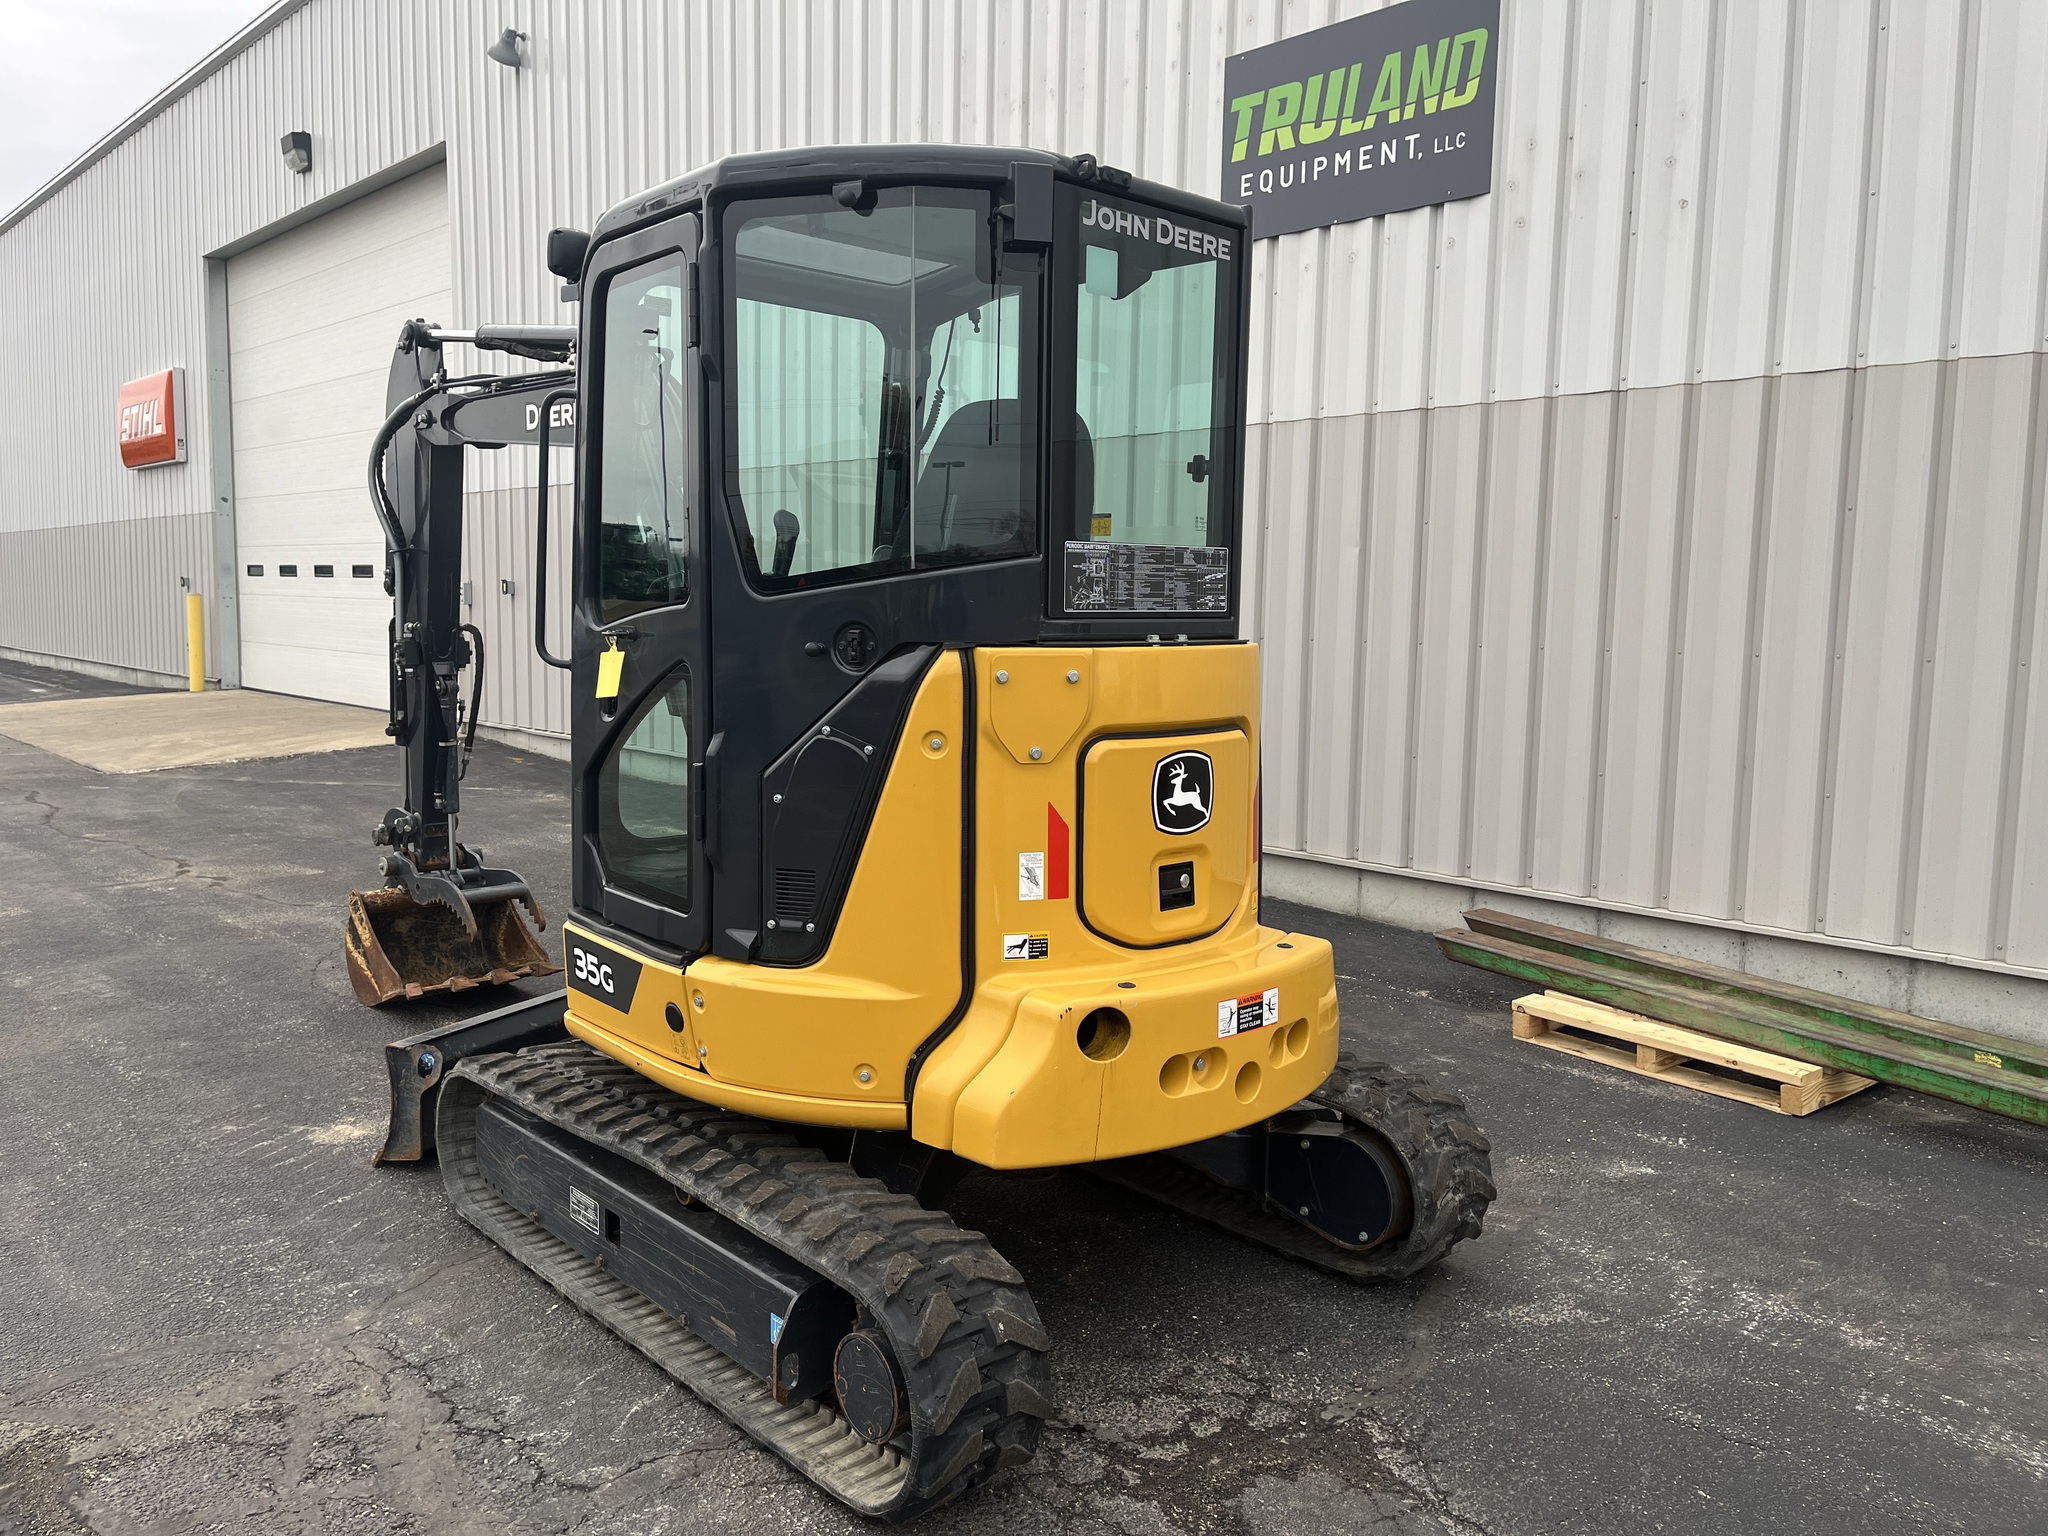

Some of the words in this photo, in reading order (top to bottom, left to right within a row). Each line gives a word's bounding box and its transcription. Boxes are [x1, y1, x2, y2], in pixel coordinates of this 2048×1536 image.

[1231, 28, 1489, 163] TRULAND
[1240, 133, 1423, 197] EQUIPMENT,
[1434, 132, 1466, 154] LLC
[1082, 199, 1150, 241] JOHN
[1156, 217, 1231, 261] DEERE
[121, 398, 163, 441] STIHL
[526, 402, 576, 430] DER
[573, 947, 615, 994] 35G
[1243, 993, 1263, 1003] WARNING
